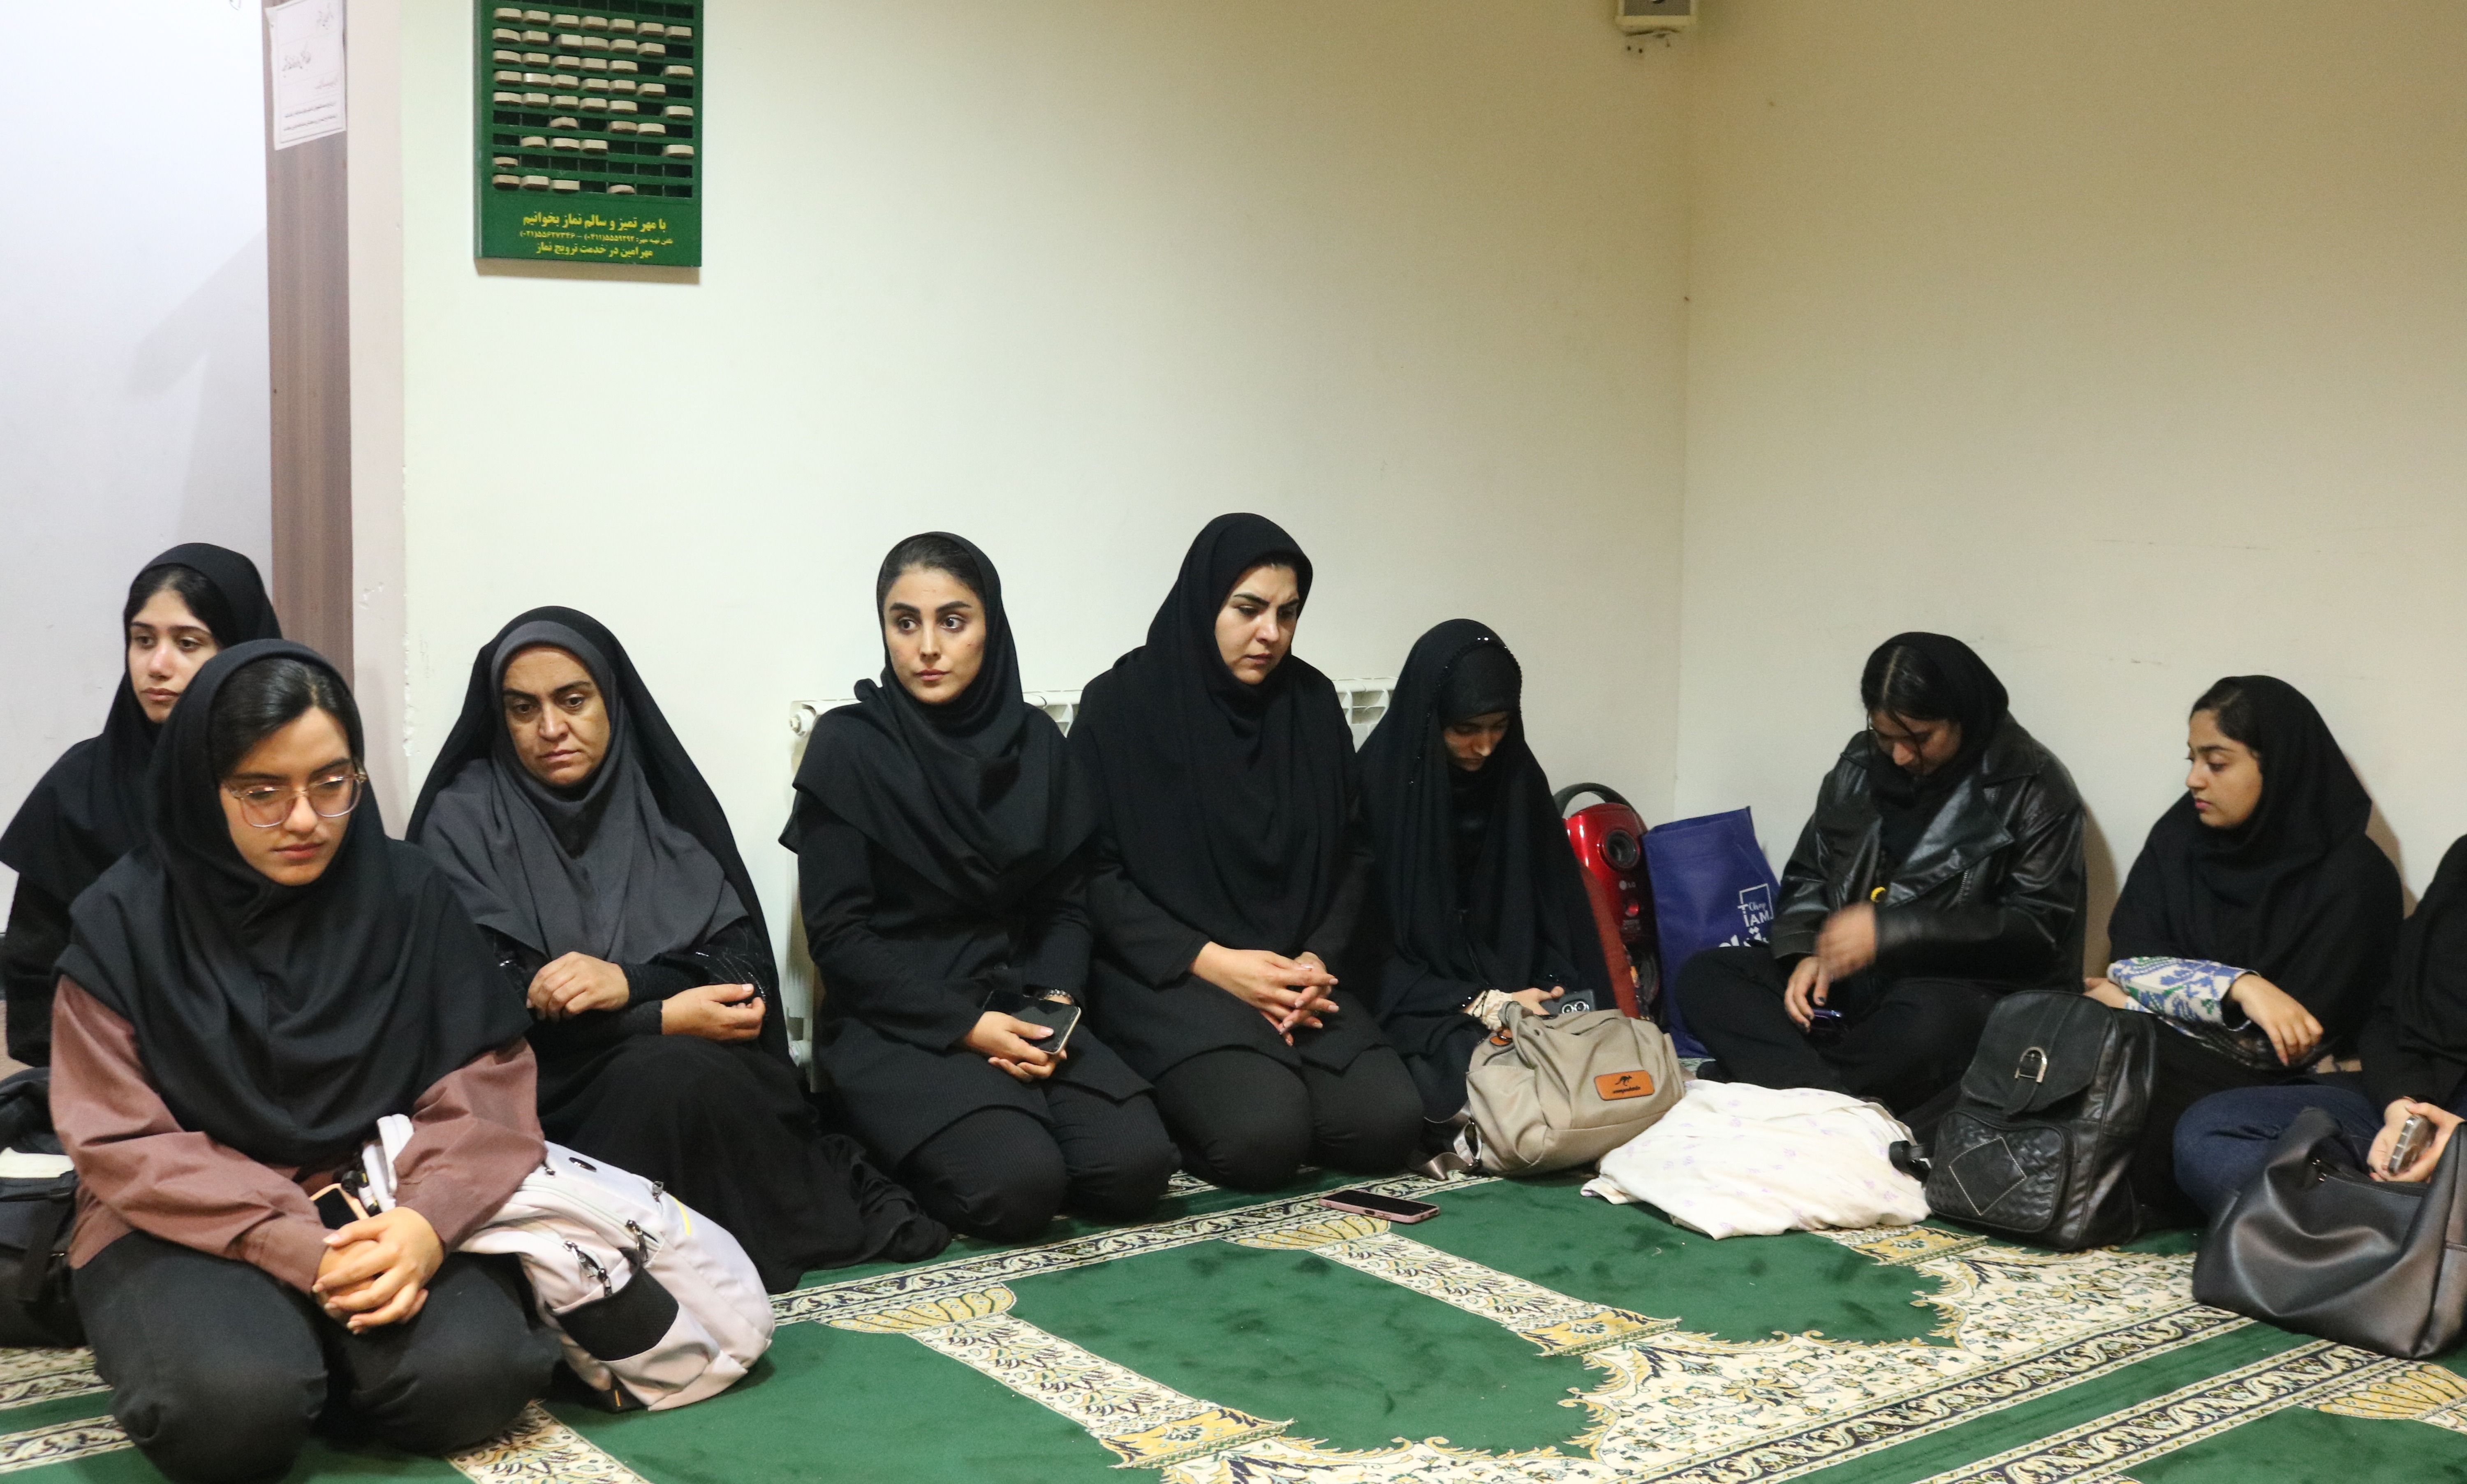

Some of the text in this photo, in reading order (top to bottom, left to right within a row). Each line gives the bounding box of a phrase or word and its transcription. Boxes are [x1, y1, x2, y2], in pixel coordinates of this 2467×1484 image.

[523, 211, 667, 233] با مهر تمیز و سالم نماز بخوانیم
[535, 241, 654, 259] مهر امین در خدمت ترویج نماز
